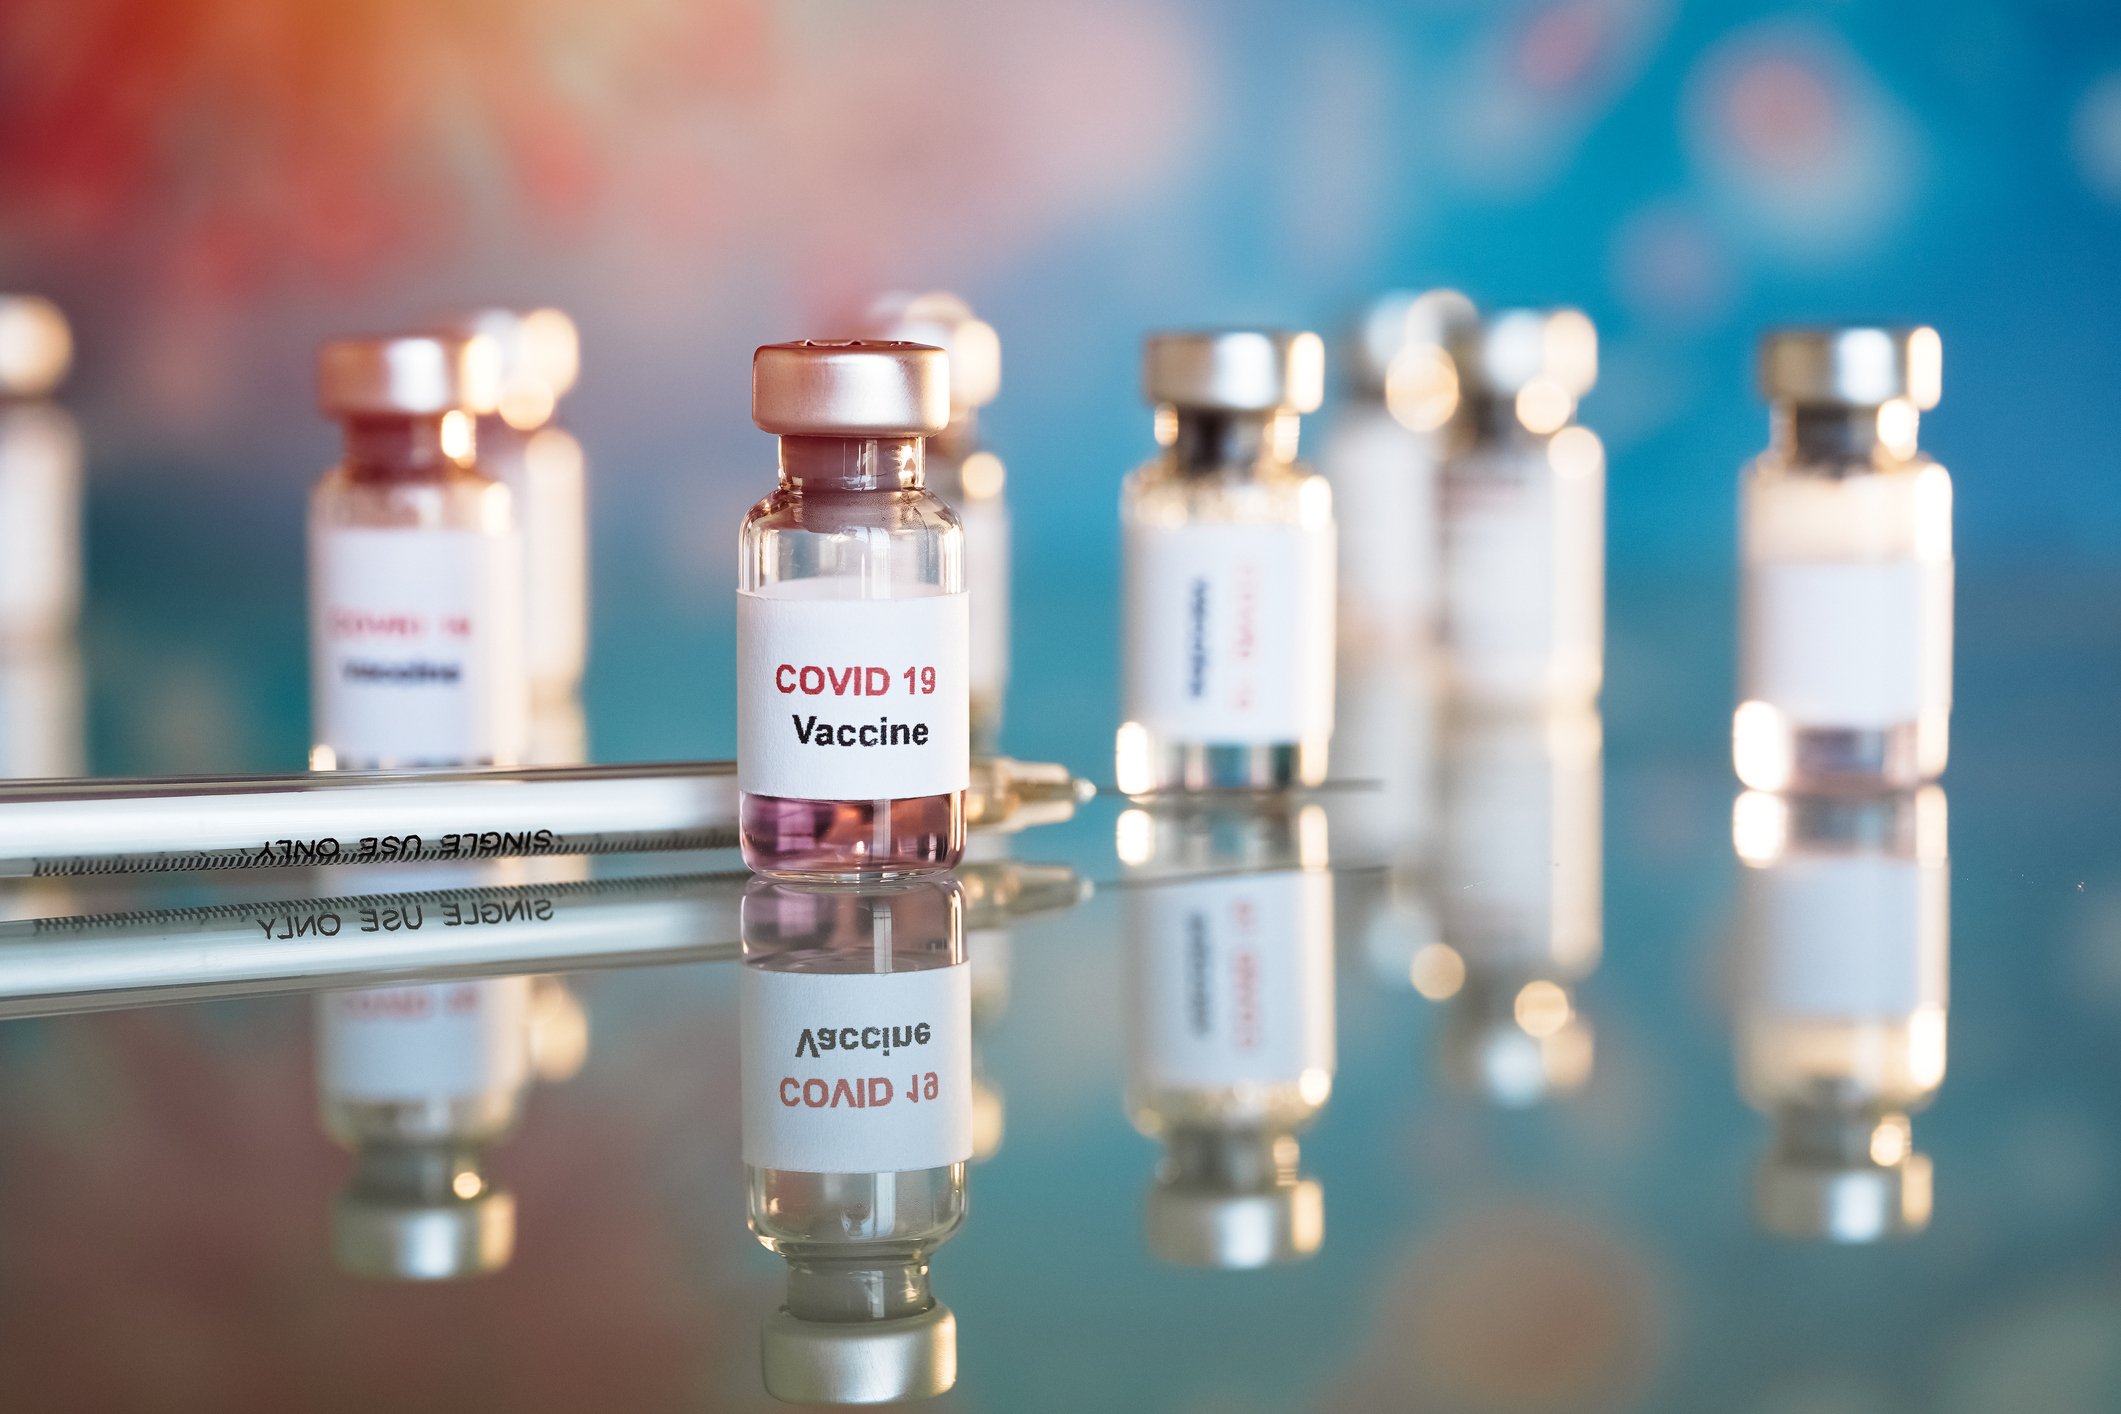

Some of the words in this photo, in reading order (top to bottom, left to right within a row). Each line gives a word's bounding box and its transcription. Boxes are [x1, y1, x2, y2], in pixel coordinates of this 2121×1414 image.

[776, 664, 891, 696] COVID
[903, 666, 936, 695] 19
[792, 714, 929, 747] Vaccine
[256, 837, 340, 860] ONLY
[359, 834, 422, 858] USE
[441, 829, 553, 854] SINGLE
